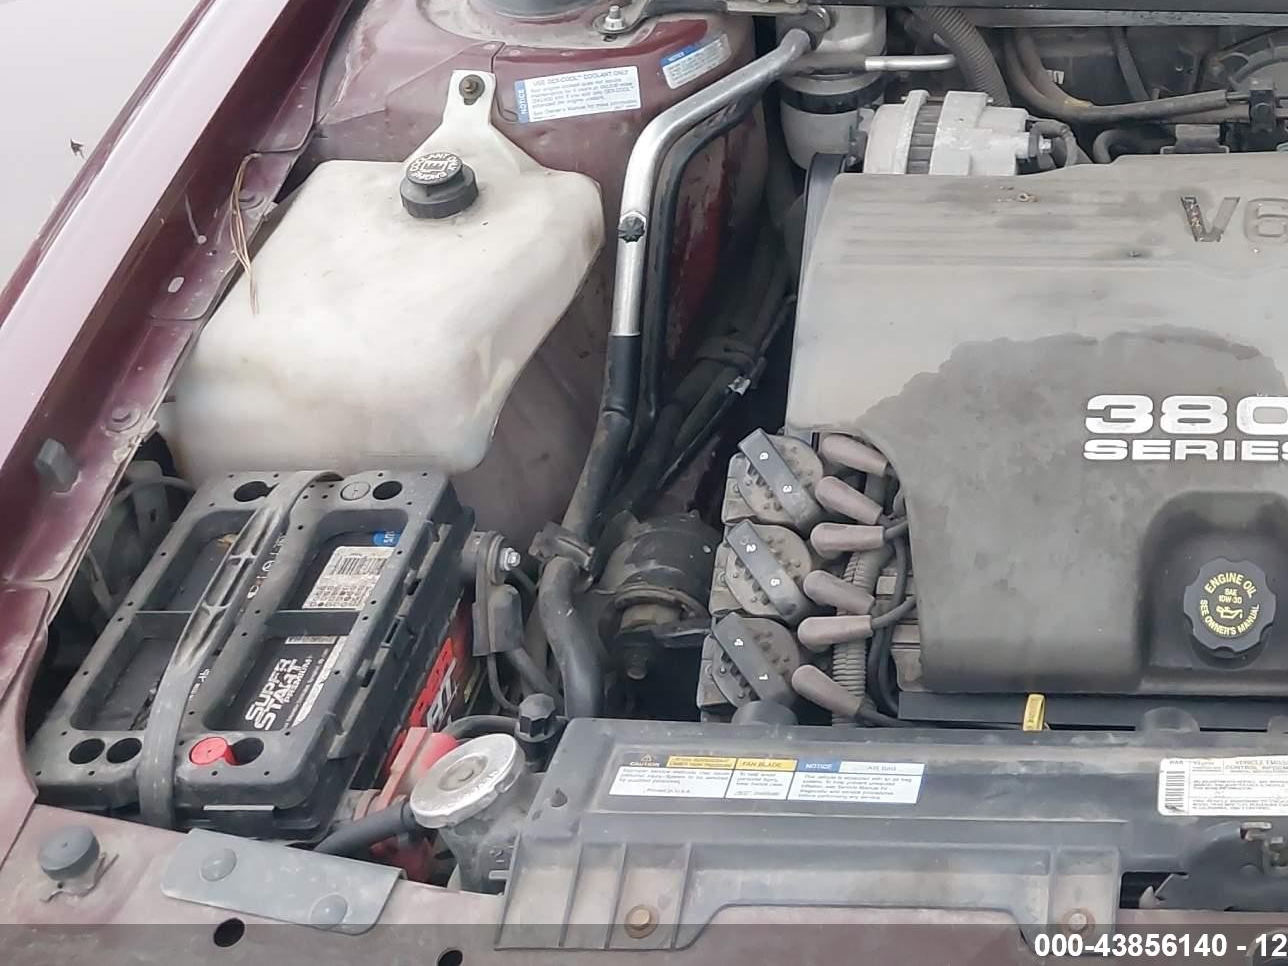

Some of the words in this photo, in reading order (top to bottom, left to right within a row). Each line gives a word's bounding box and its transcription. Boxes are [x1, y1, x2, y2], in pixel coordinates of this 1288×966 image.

[518, 89, 529, 115] NOTICE
[746, 544, 757, 552] 2
[1204, 572, 1245, 594] ENGINE
[1243, 581, 1257, 598] OIL
[1200, 599, 1210, 617] SEE
[1237, 603, 1260, 634] MANUAL
[245, 658, 293, 721] SUPER
[805, 762, 833, 770] NOTICE
